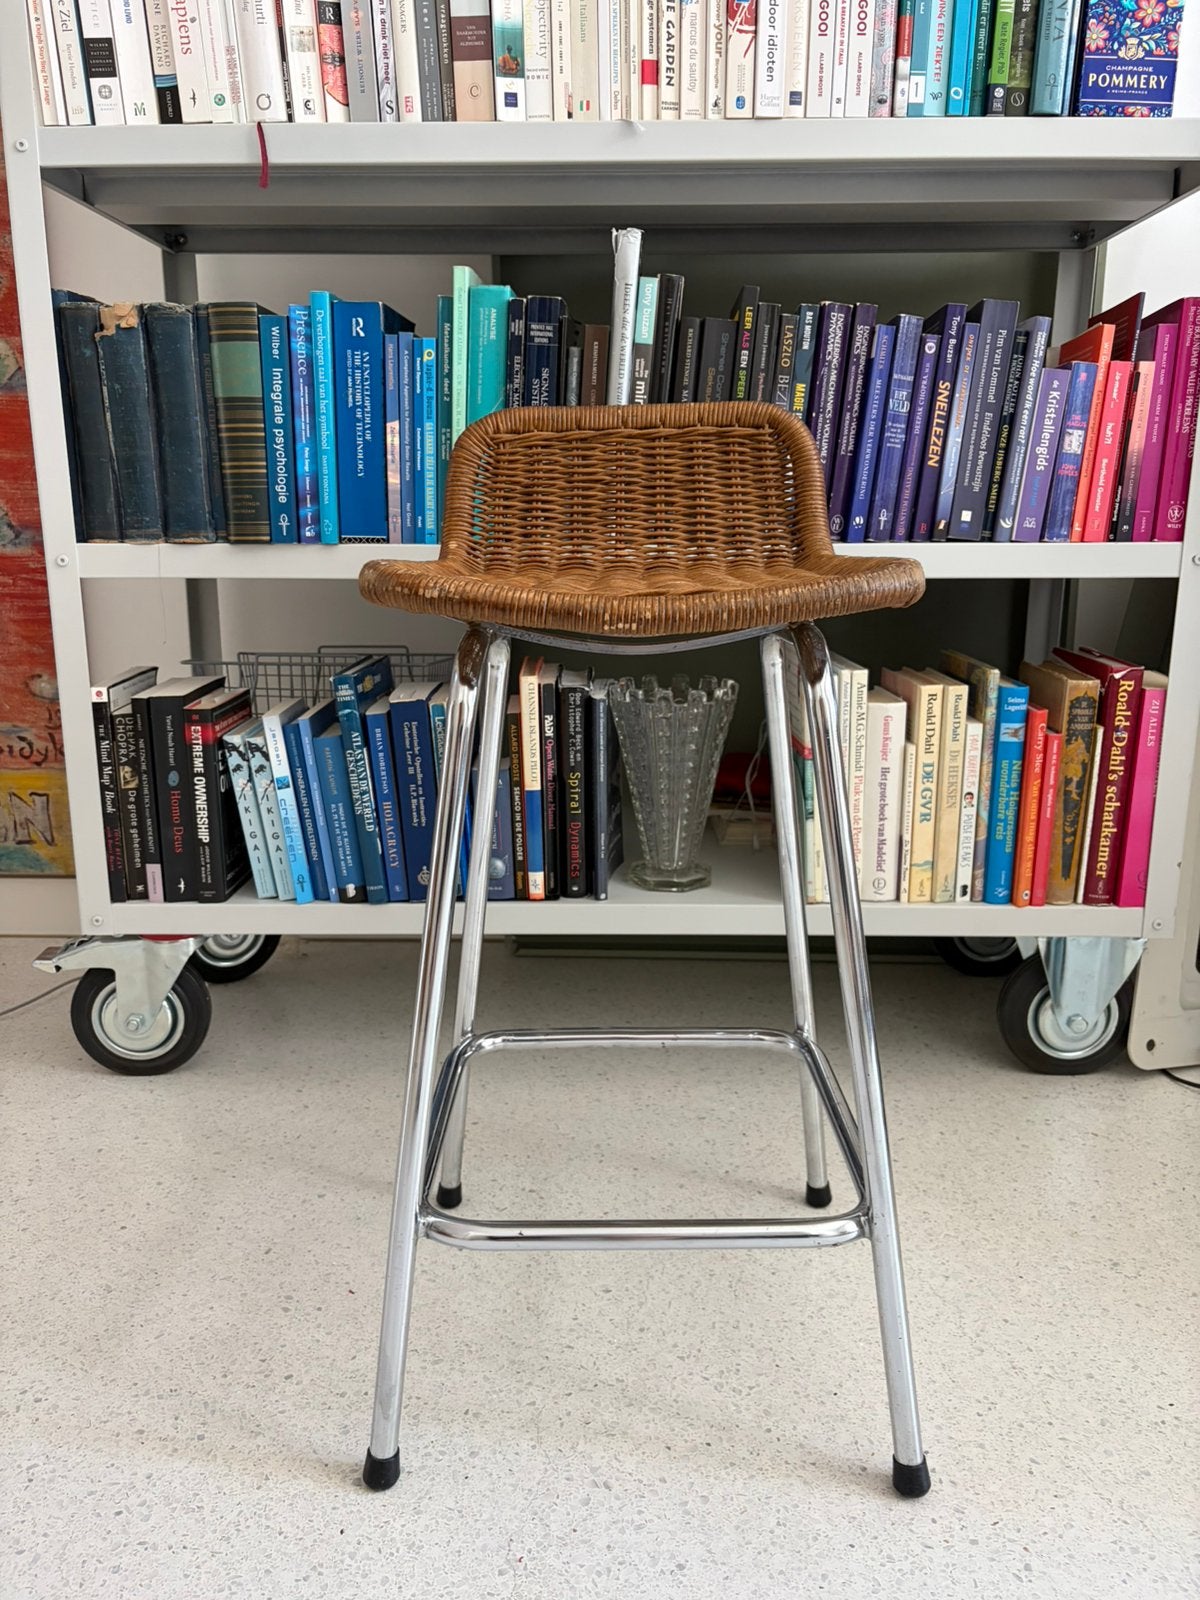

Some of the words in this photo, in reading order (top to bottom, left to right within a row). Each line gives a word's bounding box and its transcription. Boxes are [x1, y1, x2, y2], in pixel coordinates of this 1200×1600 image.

[124, 9, 132, 24] LIVIO
[768, 0, 778, 30] door
[818, 0, 829, 36] GOOI
[856, 0, 868, 35] GOOI
[980, 1, 988, 13] dat
[60, 10, 72, 32] Ziel
[380, 18, 388, 40] drink
[440, 4, 450, 64] vraagstukken
[580, 5, 588, 42] Italiaans
[690, 13, 698, 46] marcus
[980, 17, 986, 26] er
[153, 25, 163, 67] DAWKINS
[160, 25, 171, 67] RICHARD
[382, 44, 390, 60] niet
[666, 20, 675, 86] GARDEN
[690, 48, 698, 60] du
[766, 35, 778, 82] idioten
[999, 39, 1008, 60] Regier,
[383, 62, 391, 85] meer
[688, 62, 698, 92] sautoy
[997, 62, 1005, 74] PhD
[1088, 73, 1168, 89] POMMERY
[642, 284, 653, 304] tony
[316, 310, 324, 320] De
[641, 308, 652, 338] buzan
[744, 307, 754, 330] LEER
[805, 311, 814, 324] BAS
[948, 315, 960, 336] Tony
[270, 326, 282, 359] Wilber
[295, 310, 310, 375] Presence
[316, 320, 328, 364] verborgen
[742, 332, 751, 348] ALS
[781, 326, 794, 368] LASZLO
[802, 325, 812, 350] MOUTON
[824, 312, 838, 360] DYNAMICS
[828, 314, 844, 368] ENGINEERING
[853, 325, 864, 354] STATICS
[996, 329, 1007, 347] Pim
[354, 351, 362, 368] THE
[739, 350, 748, 368] EEN
[856, 326, 870, 374] ENGINEERING
[946, 339, 958, 364] Buzan
[994, 348, 1003, 363] van
[318, 366, 328, 382] taal
[1030, 359, 1039, 377] Hoe
[271, 368, 286, 424] Integrale
[318, 384, 326, 398] van
[354, 370, 362, 406] HISTORY
[736, 370, 746, 398] SPEER
[825, 369, 838, 418] MECHANICS
[852, 374, 864, 418] MECHANICS
[986, 364, 1002, 403] Lommel
[1026, 378, 1036, 400] word
[1052, 380, 1060, 388] de
[320, 400, 329, 413] het
[792, 384, 806, 412] MAGIE
[870, 379, 882, 419] MEESTERS
[1025, 400, 1033, 410] ik
[355, 408, 362, 420] OF
[928, 380, 951, 468] SNELLEZEN
[318, 415, 330, 449] symbool
[820, 424, 832, 457] VOLUME
[848, 422, 858, 452] VOLUME
[868, 421, 877, 437] DER
[979, 412, 994, 450] Eindeloos
[1018, 423, 1030, 444] rat?
[1034, 391, 1061, 472] Kristallengids
[356, 422, 364, 478] TECHNOLOGY
[272, 428, 288, 504] psychologie
[858, 438, 875, 500] VERWONDERING
[972, 451, 990, 492] bewustzijn
[1097, 458, 1109, 486] Berthold
[1094, 487, 1105, 513] Gunster
[855, 682, 866, 710] Annie
[926, 693, 938, 726] Roald
[952, 694, 962, 719] Roald
[1114, 680, 1134, 728] Roald
[1150, 698, 1160, 716] ZIJ
[115, 717, 128, 763] CHOPRA
[126, 717, 136, 758] DEEPAK
[374, 729, 383, 750] BRIAN
[510, 725, 519, 752] ALLARD
[544, 715, 554, 738] PADI
[952, 721, 961, 742] Dahl
[1034, 723, 1048, 750] Carry
[1146, 717, 1158, 746] ALLES
[190, 726, 204, 773] EXTREME
[350, 731, 364, 754] ATLAS
[544, 740, 554, 759] Open
[924, 728, 935, 754] Dahl
[355, 756, 366, 778] VAN
[376, 752, 390, 794] ROBERTSON
[512, 754, 520, 782] DROSTE
[546, 760, 555, 780] Water
[880, 767, 890, 782] Het
[921, 762, 935, 785] DE
[1010, 760, 1022, 790] Niels
[1034, 754, 1045, 774] Slee
[128, 790, 136, 802] De
[346, 750, 363, 816] GESCHIEDENIS
[360, 779, 368, 792] DE
[546, 782, 554, 802] Diver
[568, 772, 582, 816] Spiral
[878, 783, 888, 802] grote
[946, 762, 960, 809] HEKSEN
[997, 760, 1010, 819] wonderbare
[170, 791, 182, 824] Homo
[194, 776, 210, 843] OWNERSHIP
[514, 787, 522, 810] SEMCO
[878, 802, 888, 822] boek
[920, 787, 932, 823] GVR
[128, 804, 138, 826] grote
[362, 793, 374, 832] WERELD
[515, 812, 522, 820] IN
[547, 804, 556, 830] Manual
[1004, 792, 1020, 854] Holgerssons
[172, 827, 184, 854] Deus
[382, 801, 399, 869] HOLACRACY
[515, 822, 522, 832] DE
[877, 824, 885, 838] van
[996, 822, 1006, 840] reis
[1096, 785, 1118, 878] schatkamer
[130, 828, 142, 868] geheimen
[515, 834, 524, 861] POLDER
[568, 822, 582, 878] Dynamics
[876, 839, 887, 872] Madelief
